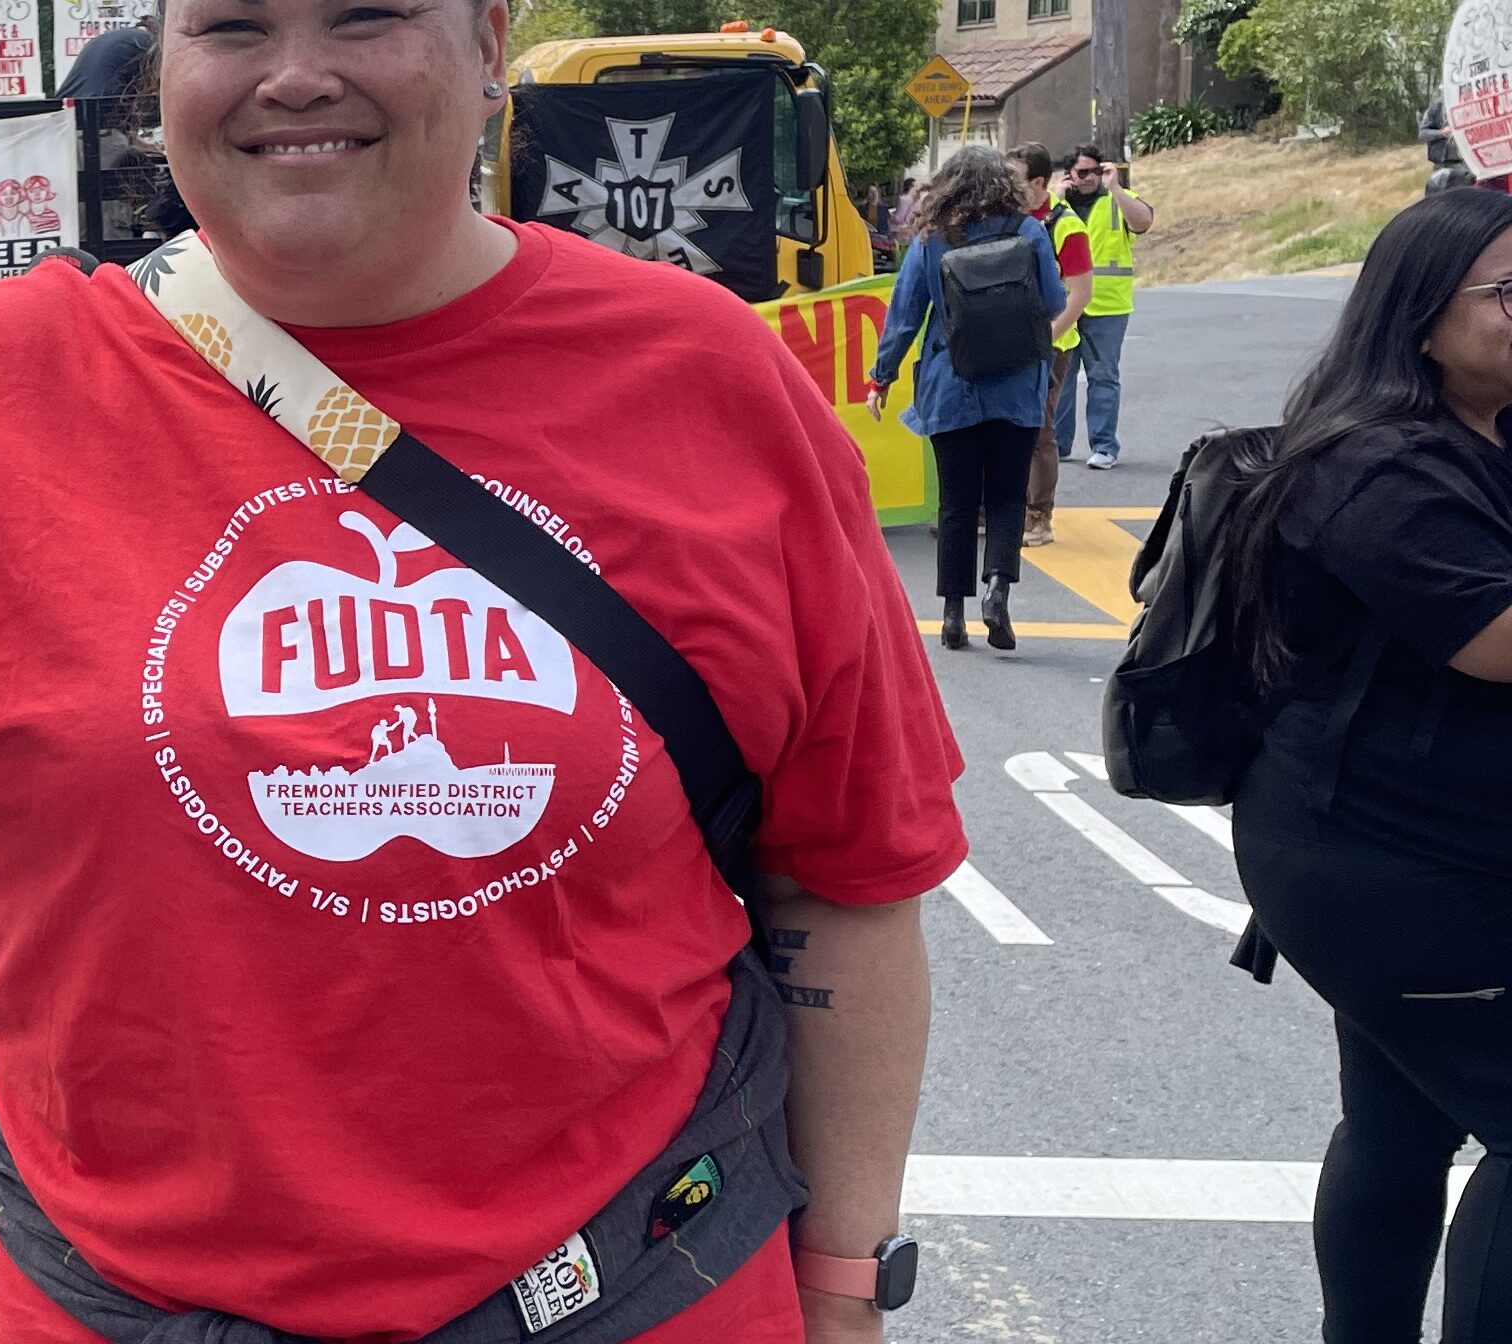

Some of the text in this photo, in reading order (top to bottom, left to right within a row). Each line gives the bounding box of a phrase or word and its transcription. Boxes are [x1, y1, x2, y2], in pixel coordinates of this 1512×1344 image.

[612, 185, 667, 231] 107
[184, 482, 307, 593] SUBSTITUTES
[142, 597, 189, 726] SPECIALISTS
[261, 594, 538, 694] FUDTA
[154, 746, 299, 897] PATHOLOGISTS
[266, 783, 537, 800] FREMONT UNIFIED DISTRICT
[281, 801, 521, 818] TEACHERS ASSOCIATION
[591, 736, 640, 829] NURSES
[309, 887, 350, 917] S/L
[379, 837, 579, 924] PSYCHOLOGISTS
